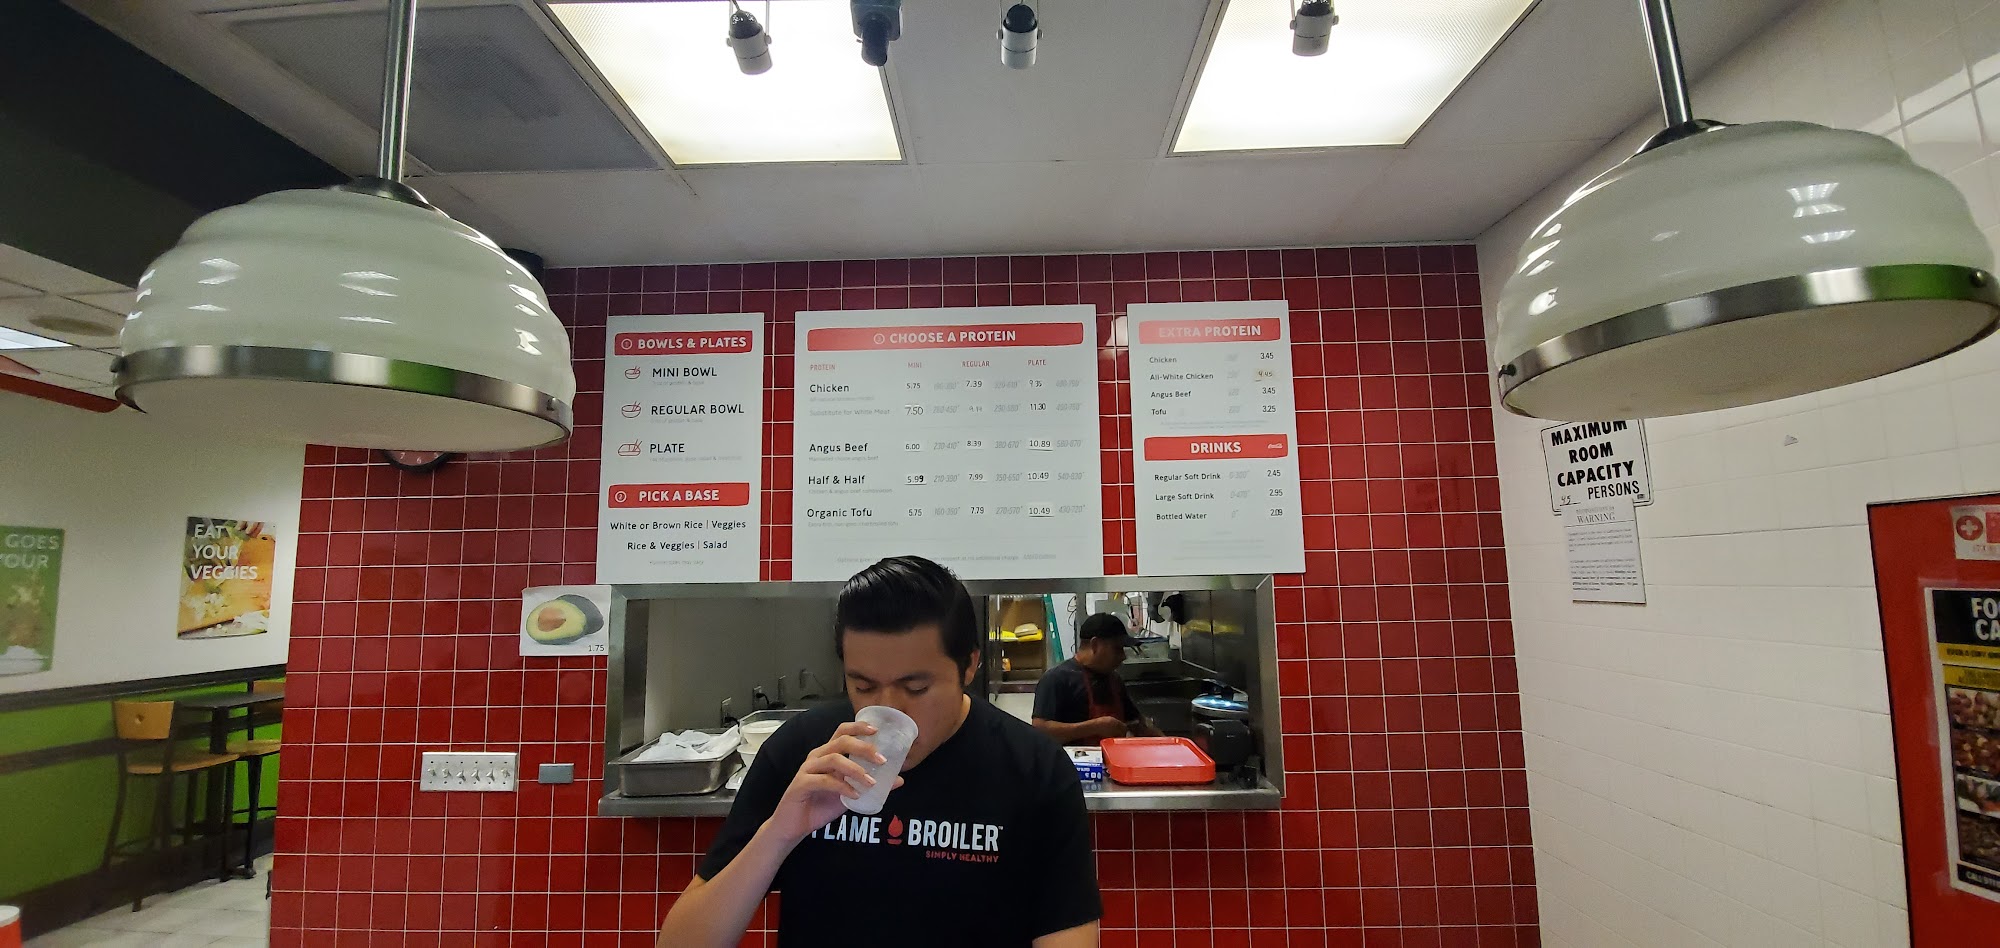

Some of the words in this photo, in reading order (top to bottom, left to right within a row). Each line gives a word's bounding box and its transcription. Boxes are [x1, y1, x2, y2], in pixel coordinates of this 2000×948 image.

[889, 332, 944, 344] CHOOSE
[947, 332, 957, 343] A
[959, 330, 1016, 343] PROTEIN
[1159, 327, 1201, 338] EXTRA
[1204, 325, 1261, 337] PROTEIN
[637, 338, 683, 350] BOWLS
[686, 337, 696, 349] &
[699, 336, 747, 348] PLATES
[962, 360, 990, 368] REGULAR
[1149, 356, 1177, 364] Chicken
[652, 367, 679, 378] MINI
[683, 366, 718, 377] BOWL
[809, 384, 850, 393] Chicken
[906, 382, 921, 390] 5.75
[965, 380, 983, 388] 7.39
[1150, 391, 1173, 399] Angus
[1175, 390, 1192, 398] Beef
[651, 404, 706, 416] REGULAR
[710, 403, 745, 414] BOWL
[843, 408, 852, 416] for
[904, 406, 924, 416] 7.50
[1030, 403, 1047, 411] 11.30
[1551, 420, 1628, 446] MAXIMUM
[649, 443, 685, 454] PLATE
[809, 443, 841, 454] Angus
[844, 443, 869, 452] Beef
[966, 440, 982, 448] 8.39
[1029, 439, 1051, 448] 10.89
[1190, 441, 1242, 454] DRINKS
[1568, 441, 1614, 464] ROOM
[808, 475, 830, 485] Half
[832, 476, 840, 485] &
[844, 475, 866, 485] Half
[907, 475, 924, 483] 5.99
[968, 473, 984, 481] 7.99
[1027, 472, 1050, 480] 10.49
[1154, 473, 1182, 482] Regular
[1201, 472, 1221, 480] Drink
[1557, 460, 1634, 487] CAPACITY
[638, 490, 670, 502] PICK
[672, 490, 682, 501] A
[685, 489, 720, 501] BASE
[1587, 480, 1640, 500] PERSONS
[1155, 493, 1176, 502] Large
[1194, 492, 1214, 500] Drink
[807, 508, 848, 519] Organic
[850, 508, 873, 517] Tofu
[908, 509, 923, 517] 5.75
[970, 506, 985, 515] 7.79
[1029, 507, 1051, 515] 10.49
[1184, 512, 1207, 520] Water
[1577, 511, 1616, 524] WARNING
[194, 523, 224, 540] EAT
[610, 521, 637, 530] White
[639, 522, 649, 530] or
[652, 521, 681, 530] Brown
[684, 520, 703, 529] Rice
[711, 519, 747, 531] Veggies
[5, 534, 60, 551] GOES
[627, 541, 647, 550] Rice
[649, 541, 657, 550] &
[660, 541, 695, 552] Veggies
[703, 540, 728, 549] Salad
[192, 545, 240, 561] YOUR
[191, 565, 258, 581] VEGGIES
[1971, 597, 2000, 619] FO
[588, 644, 605, 652] 1.75
[925, 850, 957, 861] SIMPLY
[959, 853, 1000, 864] HEALTHY
